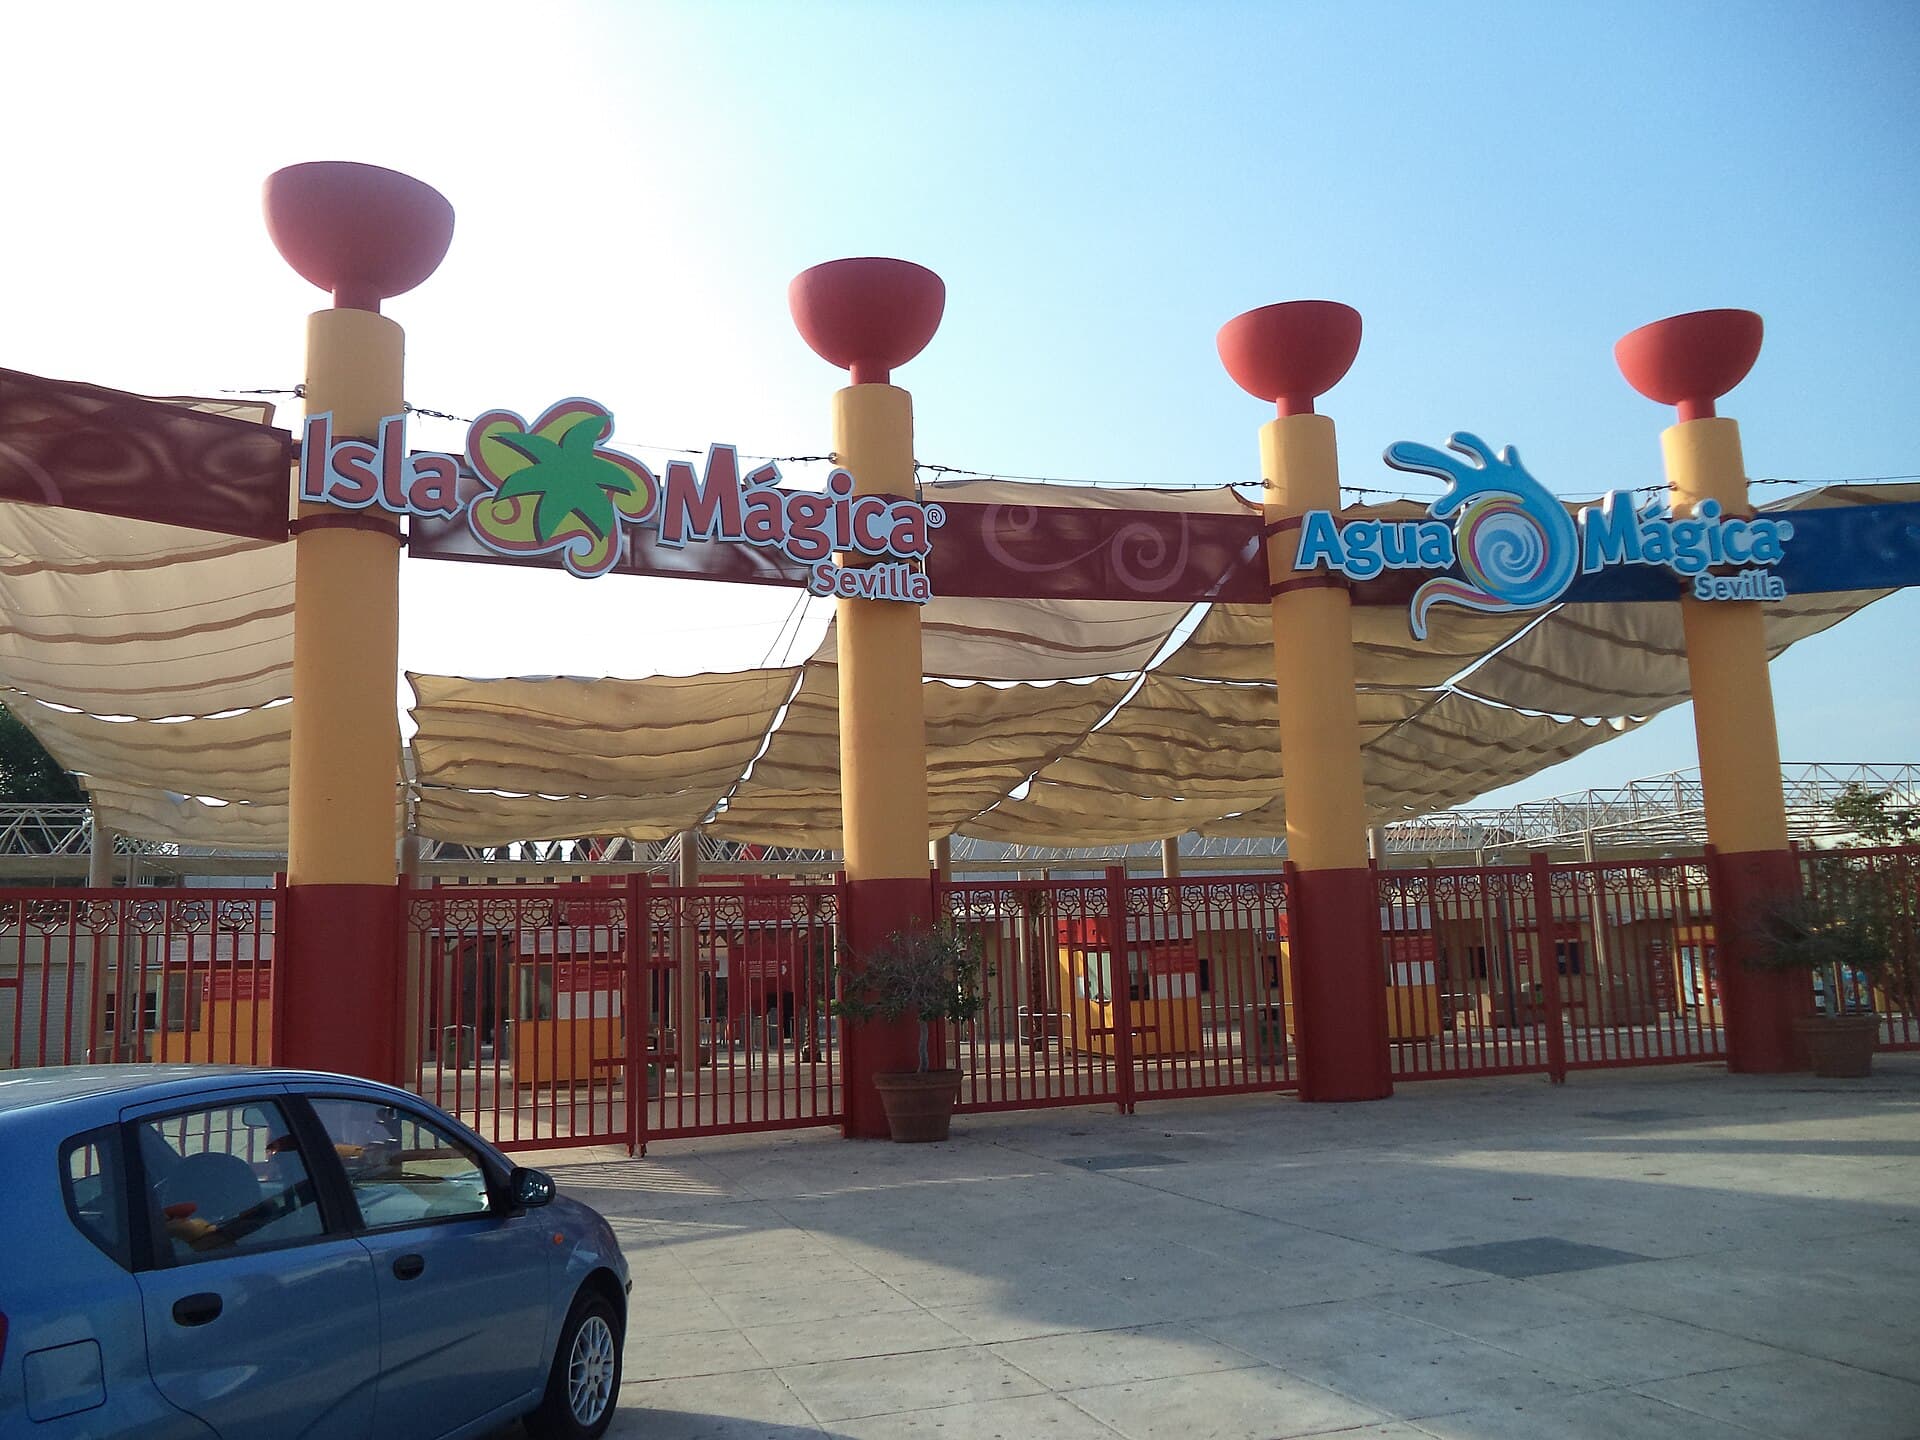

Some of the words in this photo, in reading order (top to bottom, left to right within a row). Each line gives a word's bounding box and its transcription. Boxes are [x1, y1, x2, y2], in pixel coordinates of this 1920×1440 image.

[301, 411, 466, 520] Isla
[1294, 510, 1456, 581] Agua
[808, 562, 932, 605] Sevilla
[1694, 568, 1787, 601] Sevilla
